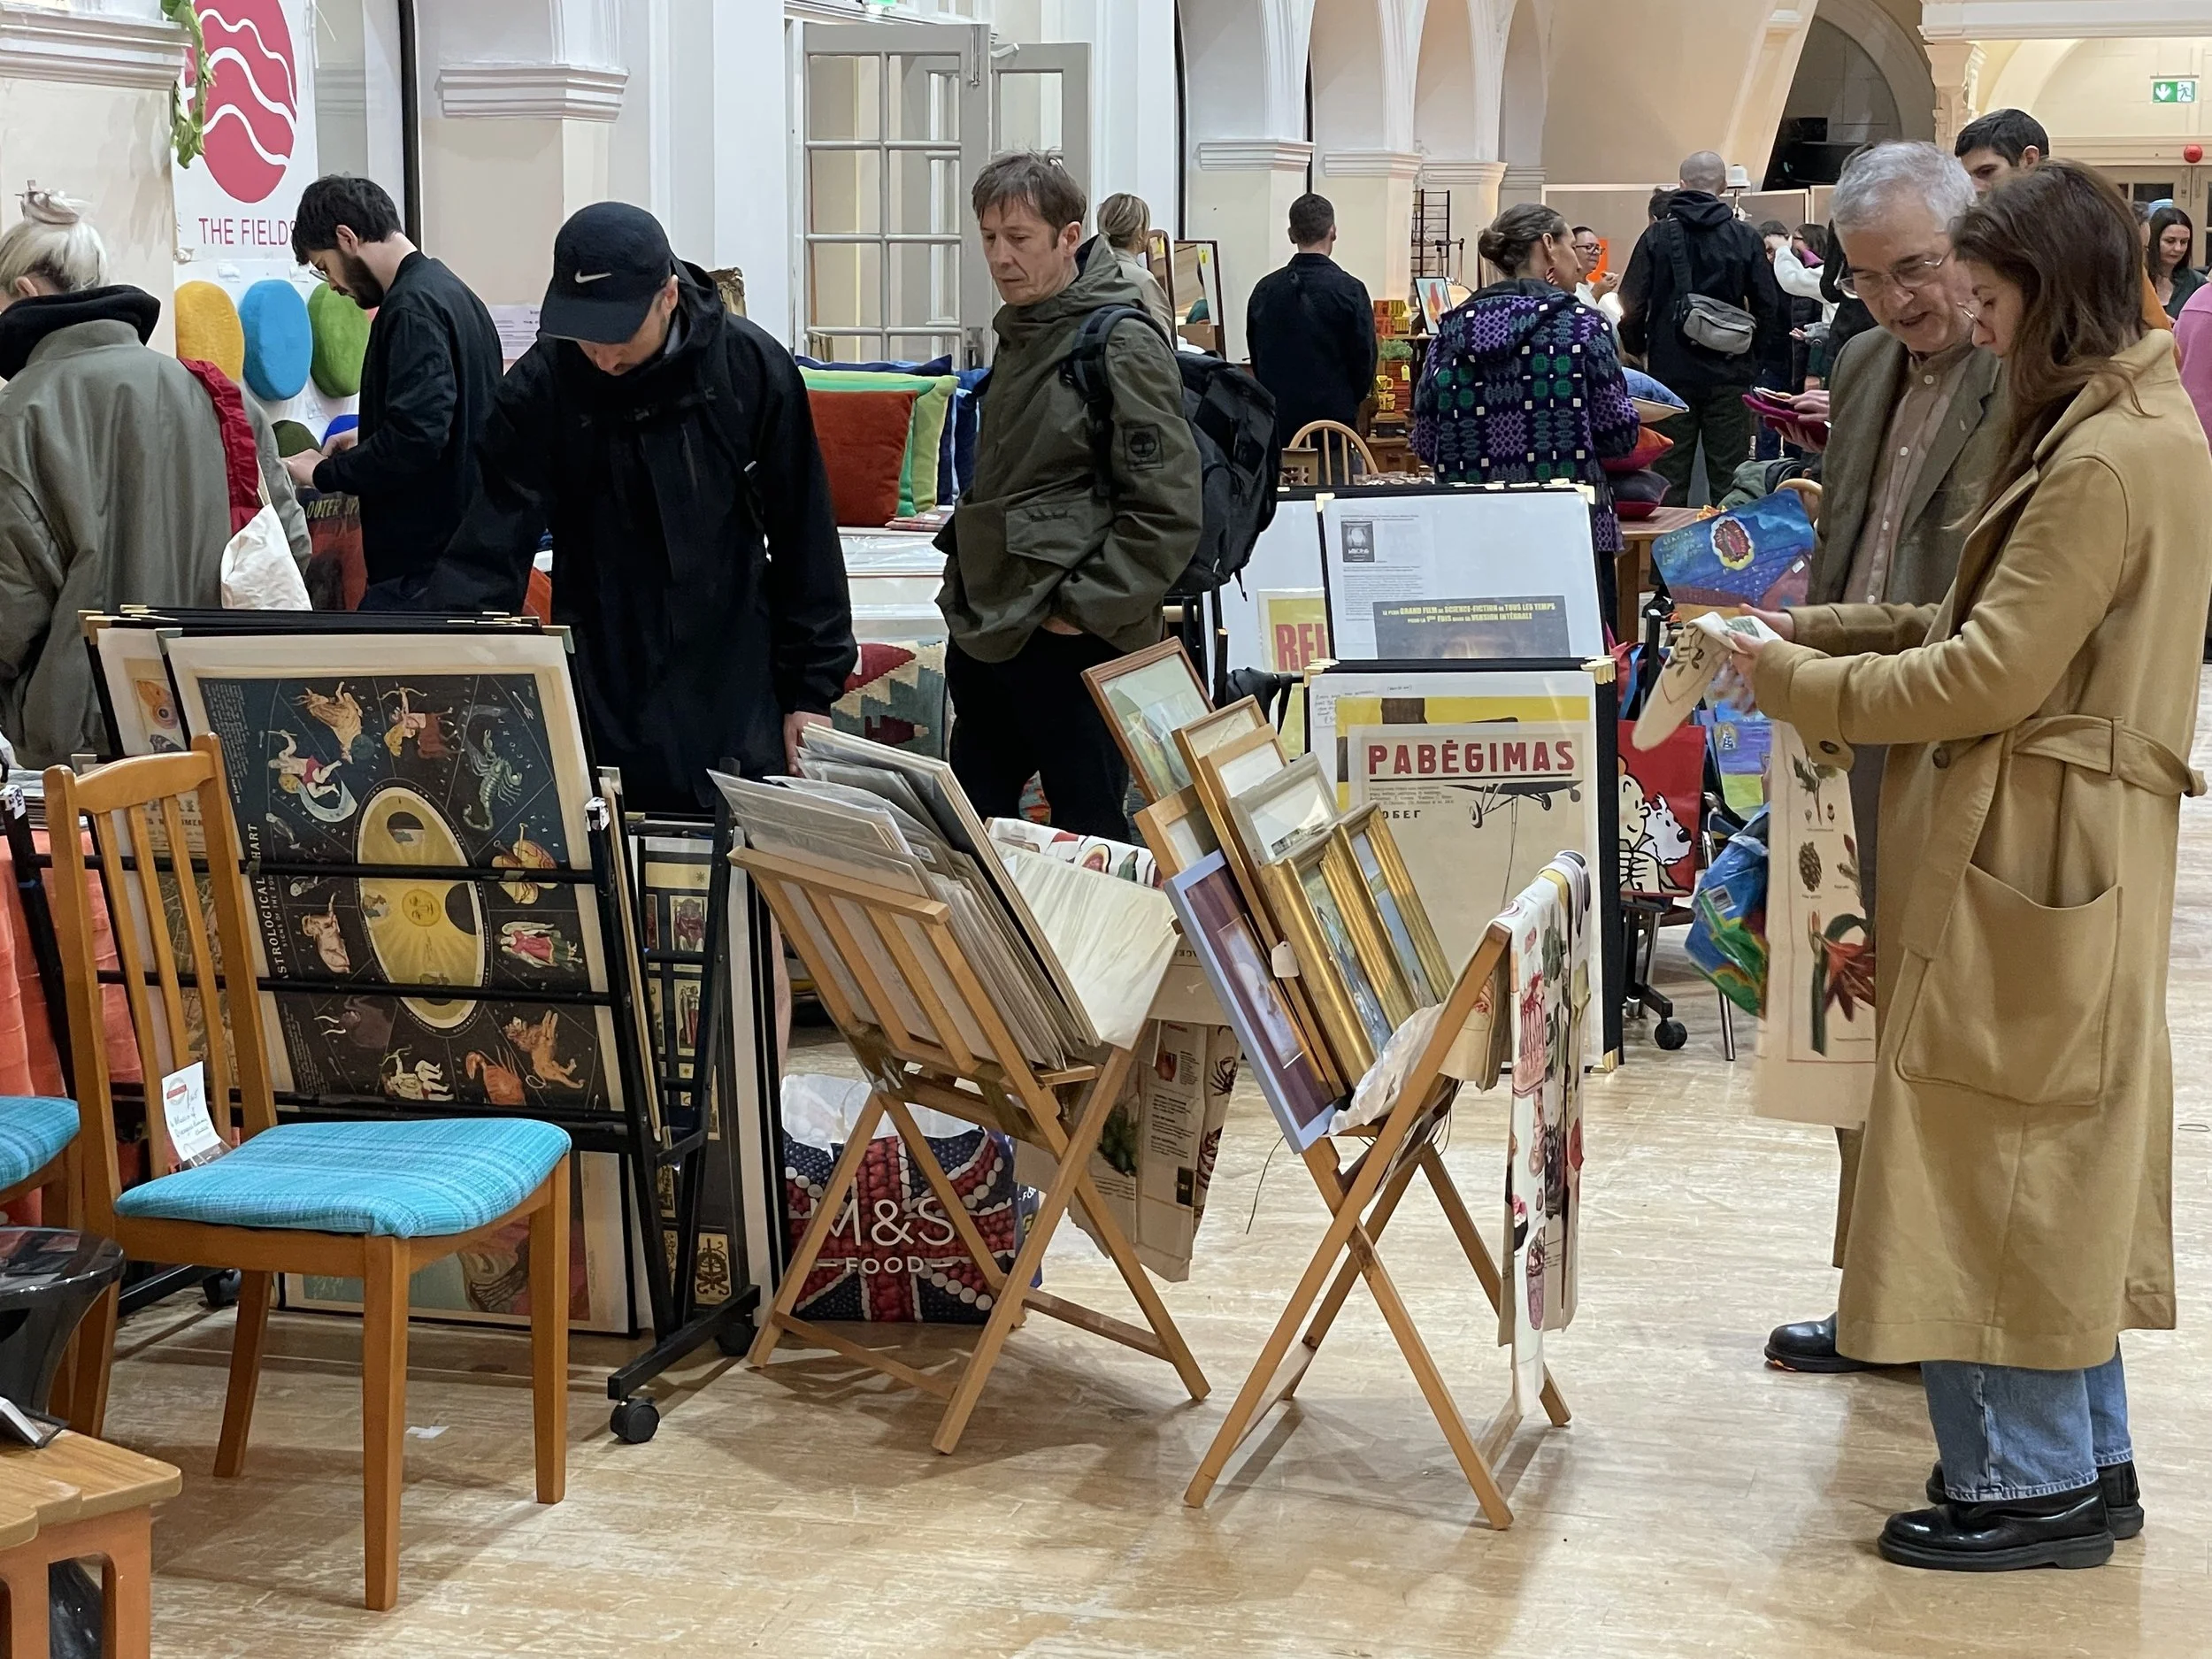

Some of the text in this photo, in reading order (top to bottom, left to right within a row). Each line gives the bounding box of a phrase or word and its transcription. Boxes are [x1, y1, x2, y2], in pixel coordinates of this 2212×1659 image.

[198, 218, 234, 245] THE
[1444, 604, 1498, 613] SCIENCE-FICTION
[1504, 603, 1522, 611] TOUS
[1499, 611, 1532, 620] INTÉGRALE
[1368, 739, 1575, 775] PABĖGIMAS
[1382, 810, 1421, 819] ОБЕГ
[247, 823, 262, 859] HART
[810, 1196, 956, 1247] M&S
[845, 1256, 925, 1275] FOOD
